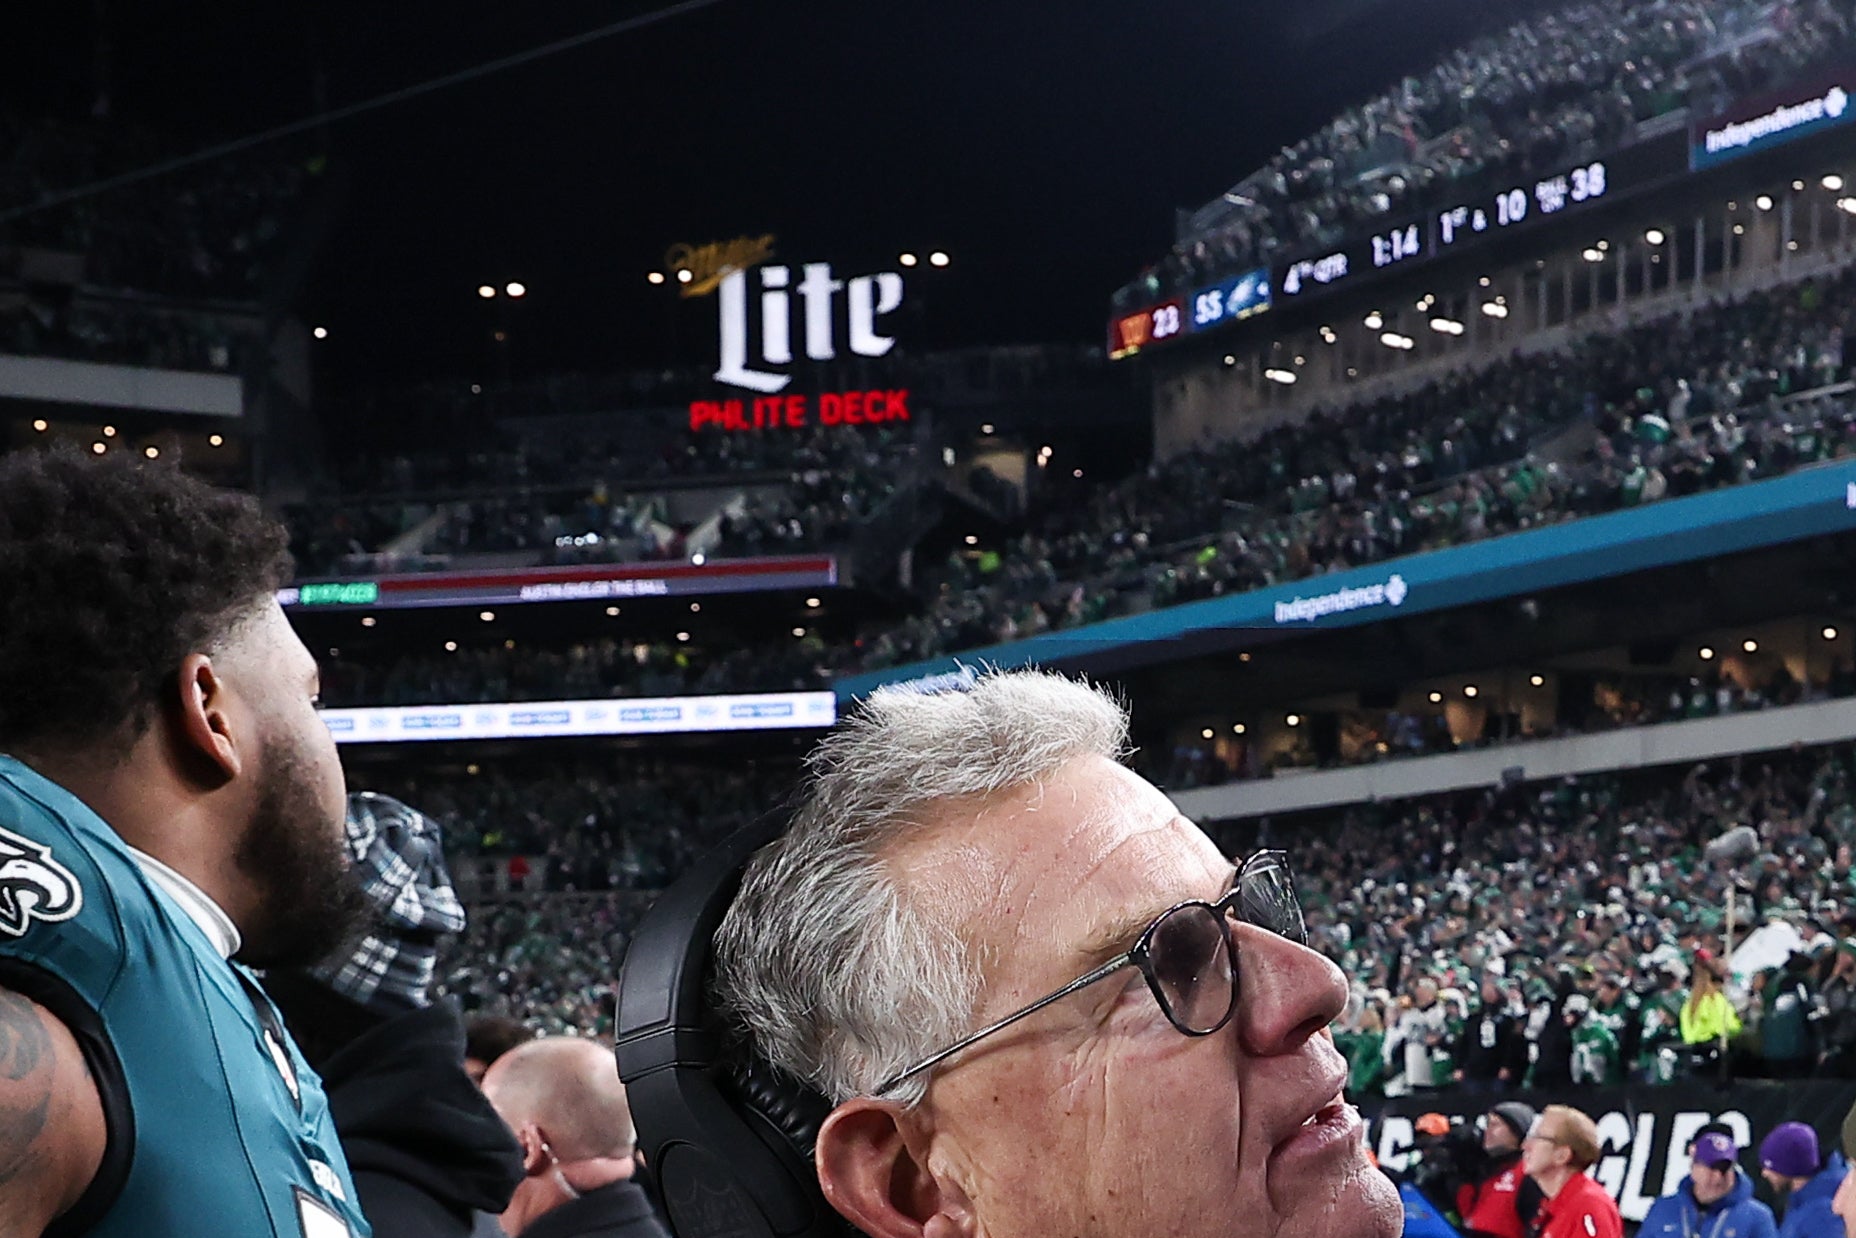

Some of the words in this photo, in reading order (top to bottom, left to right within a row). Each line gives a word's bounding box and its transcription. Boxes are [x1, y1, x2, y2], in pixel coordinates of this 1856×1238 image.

[1498, 189, 1526, 226] 10
[1372, 224, 1419, 267] 1:14
[713, 262, 903, 393] Lite
[690, 395, 806, 431] PHLITE
[819, 389, 910, 423] DECK
[1275, 583, 1384, 623] Independence
